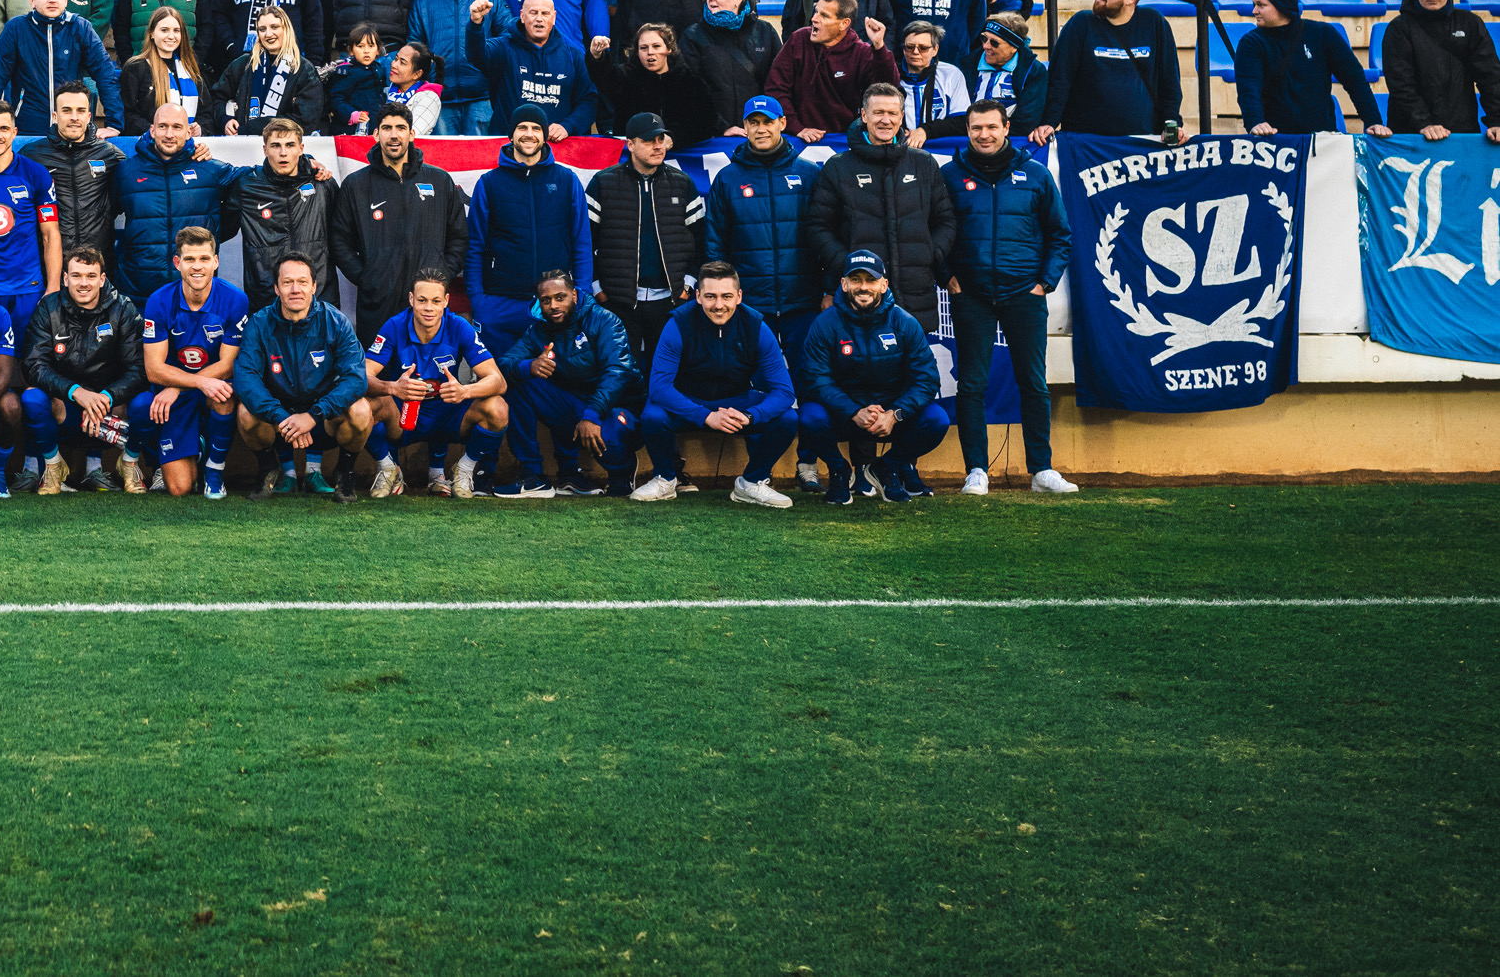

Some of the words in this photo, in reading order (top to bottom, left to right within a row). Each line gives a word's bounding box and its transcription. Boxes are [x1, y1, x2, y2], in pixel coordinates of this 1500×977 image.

[1078, 140, 1222, 199] HERTHA
[1230, 138, 1298, 174] BSC
[1141, 194, 1262, 297] SZ
[184, 351, 201, 364] B
